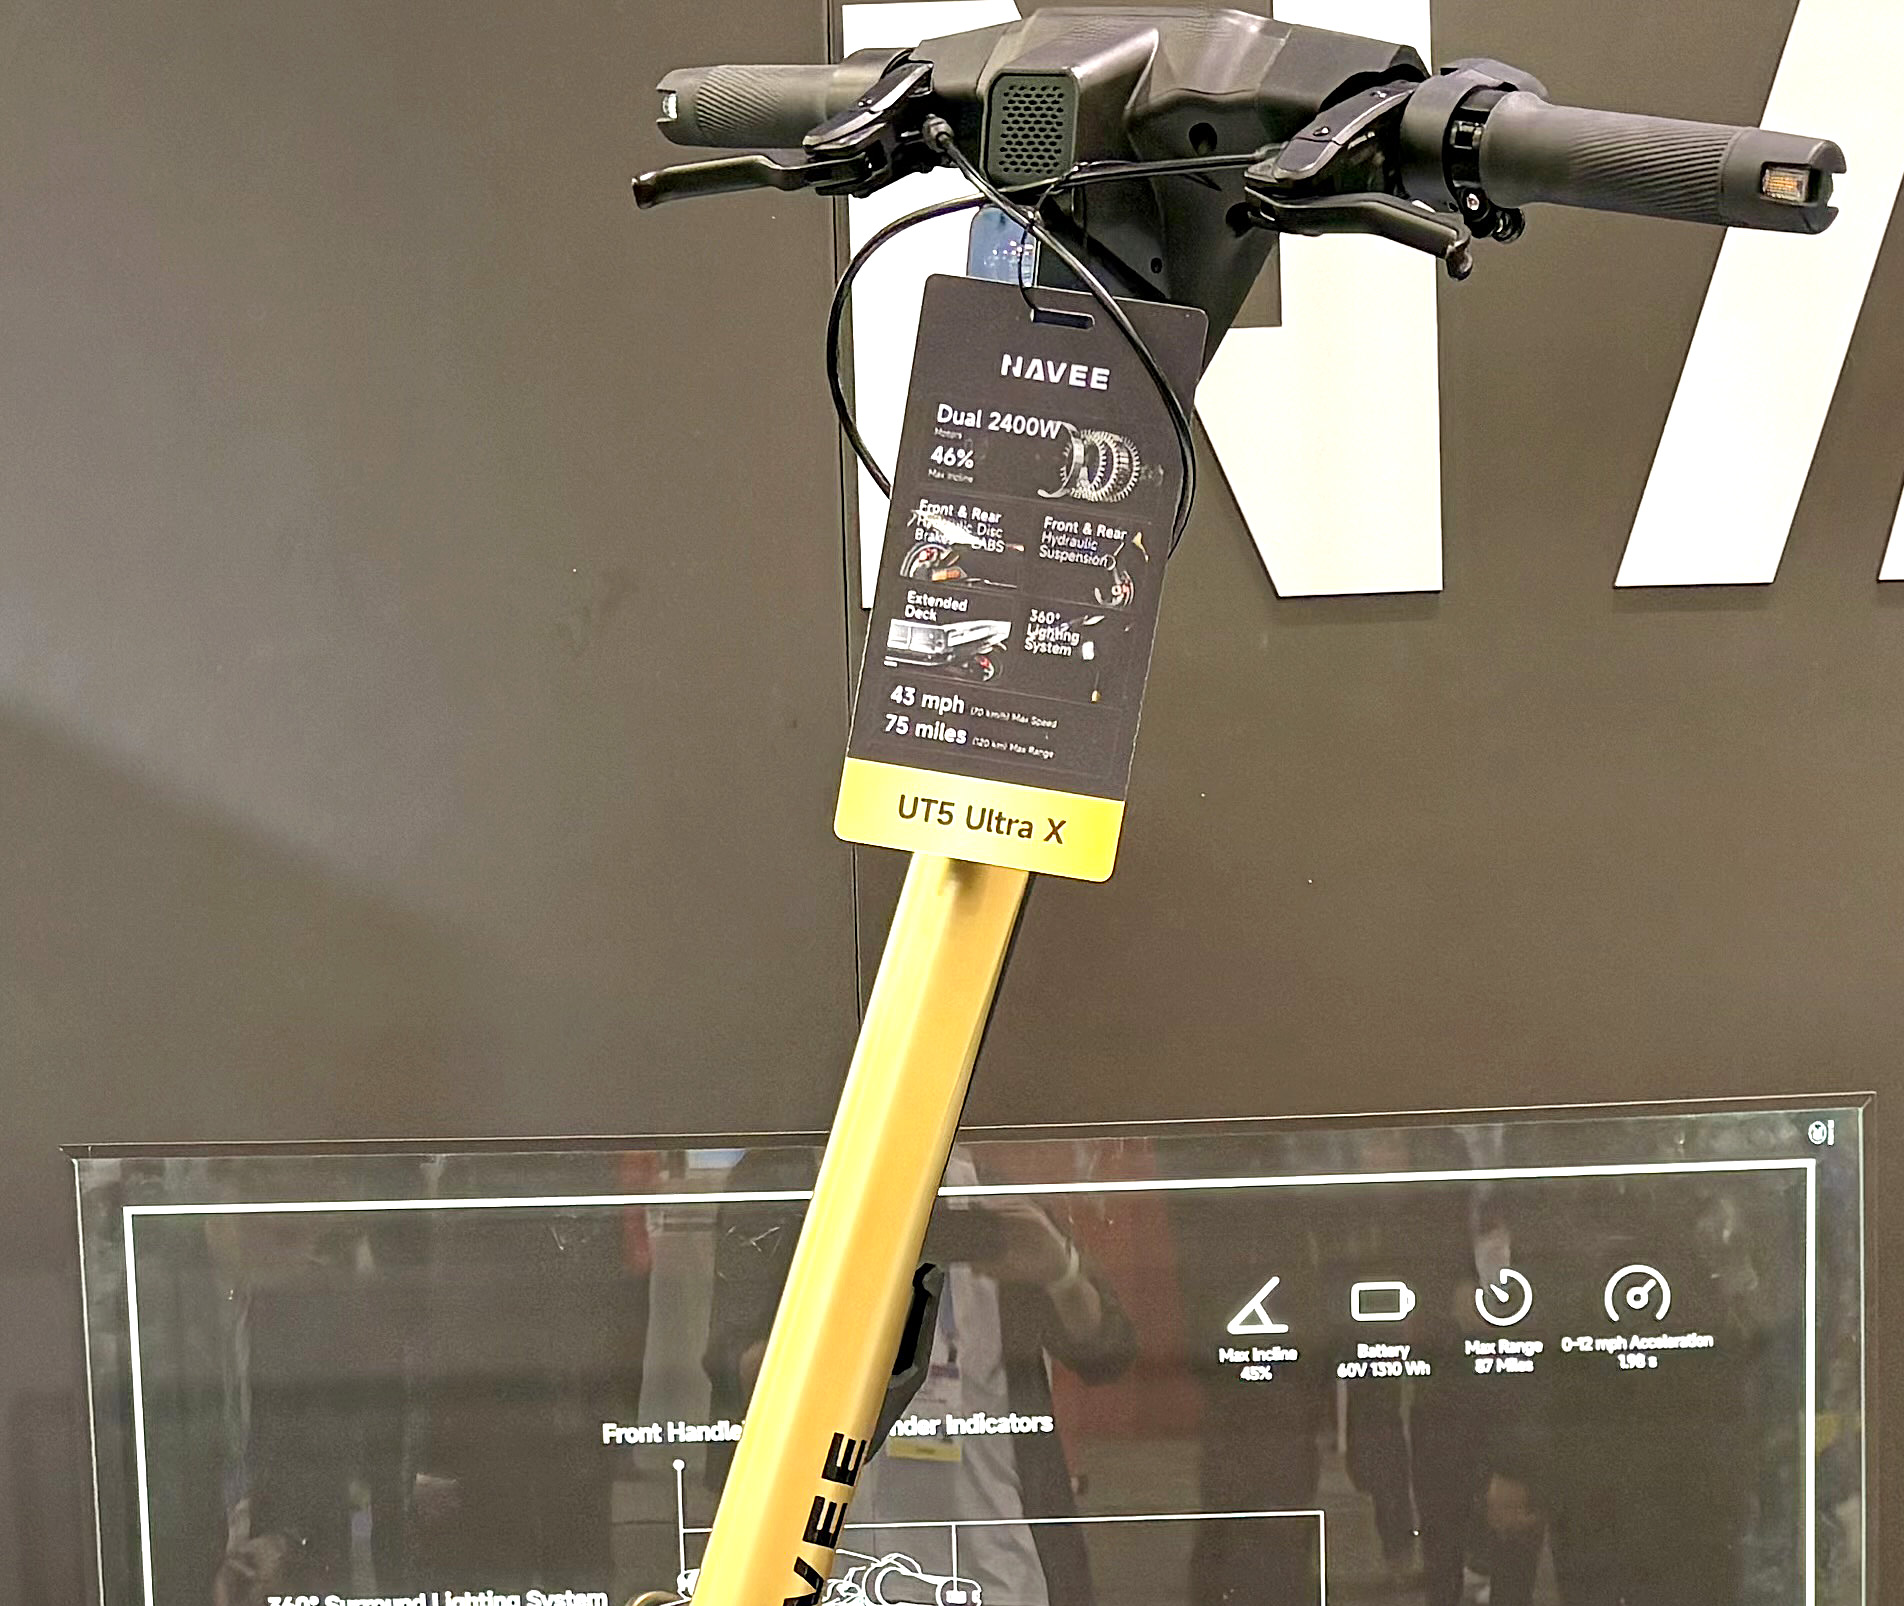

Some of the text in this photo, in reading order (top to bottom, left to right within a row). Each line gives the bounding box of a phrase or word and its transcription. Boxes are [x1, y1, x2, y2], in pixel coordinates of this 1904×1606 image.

[1000, 353, 1111, 391] NAVEE
[936, 403, 1062, 440] Dual 2400W
[930, 445, 974, 469] 46%
[919, 498, 1002, 523] Front & Rear
[977, 522, 1004, 539] Disc
[1044, 515, 1128, 541] Front & Rear
[1041, 531, 1098, 551] Hydraulic
[1039, 547, 1108, 569] Suspension
[907, 590, 969, 612] Extended
[904, 607, 938, 622] Deck
[1029, 608, 1061, 625] 360°
[1026, 622, 1081, 647] Lighting
[1024, 637, 1073, 657] System
[890, 685, 916, 706] 43
[921, 692, 965, 716] mph
[884, 713, 910, 736] 75
[914, 720, 968, 745] miles
[898, 794, 1067, 845] UT5 Ultra X
[1357, 1343, 1411, 1361] Battery
[1465, 1338, 1544, 1357] Max Range
[1629, 1332, 1714, 1351] Acceleration
[1219, 1347, 1250, 1363] Max
[1337, 1362, 1368, 1378] 60V
[1405, 1360, 1431, 1376] Wh
[602, 1422, 663, 1444] Front
[667, 1420, 744, 1444] Handle
[946, 1411, 1054, 1436] Indicators
